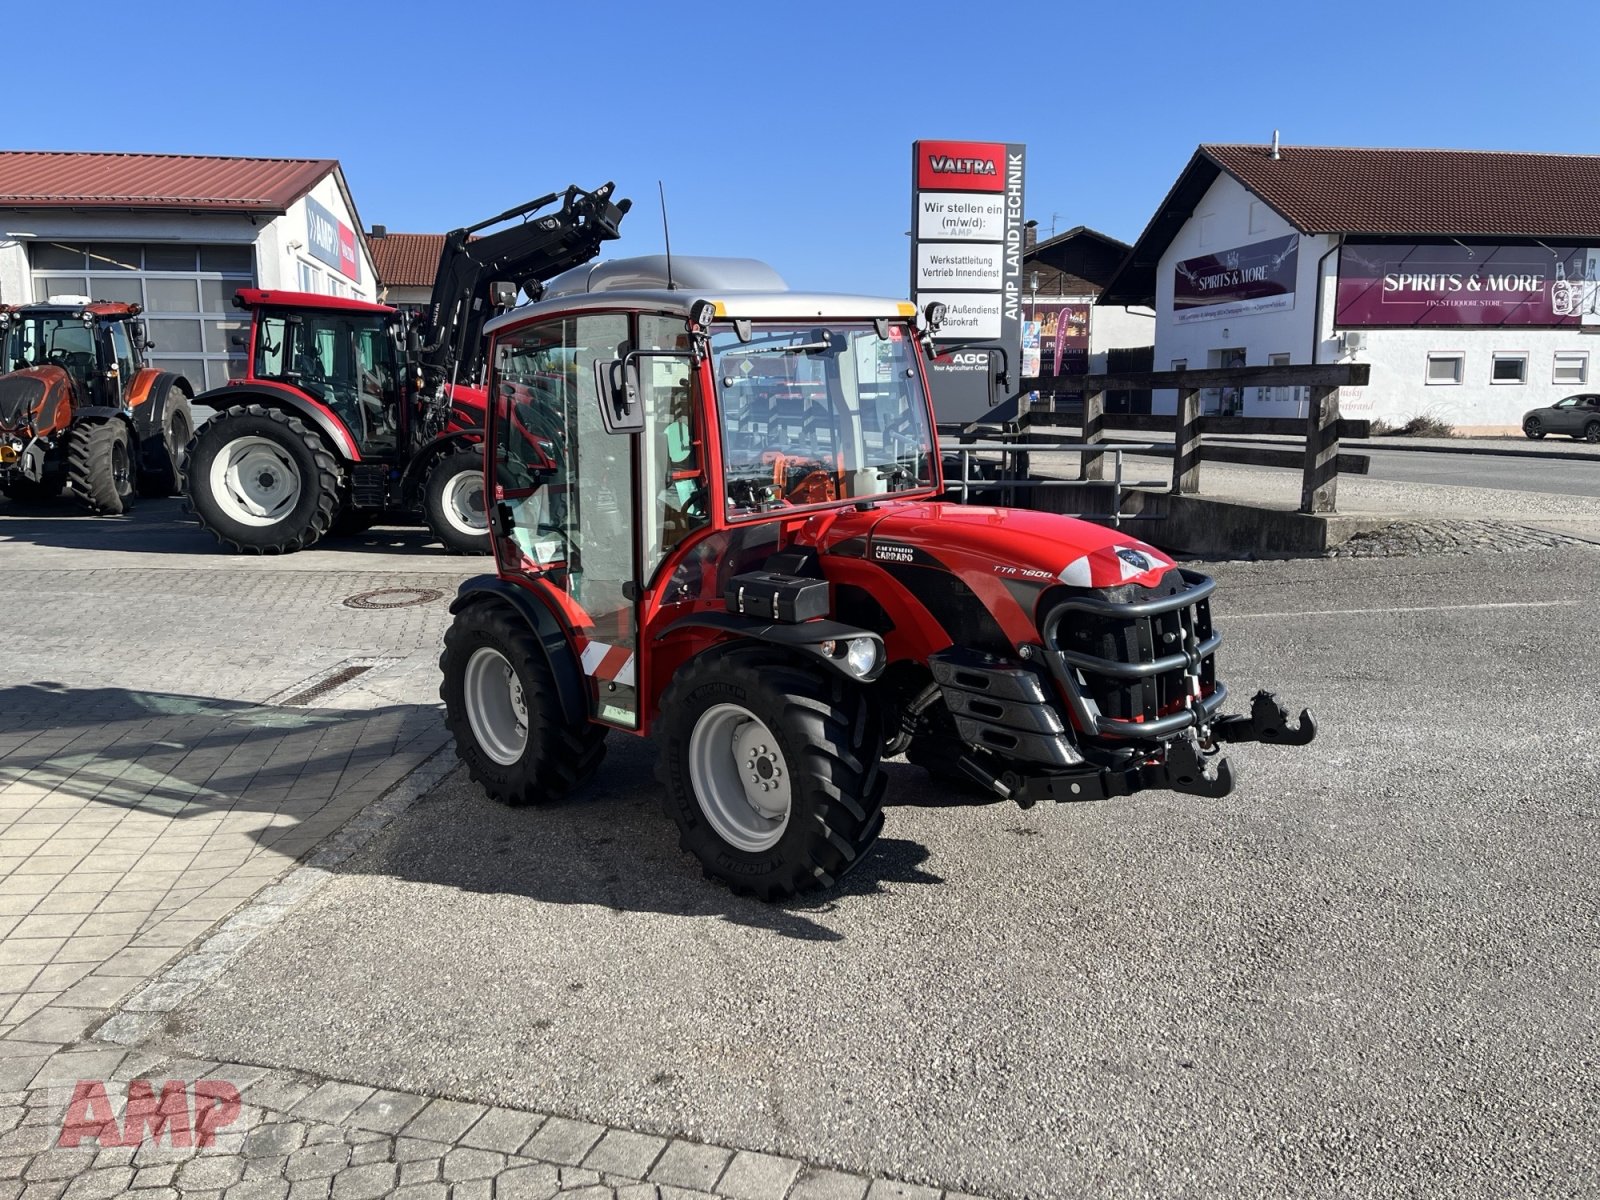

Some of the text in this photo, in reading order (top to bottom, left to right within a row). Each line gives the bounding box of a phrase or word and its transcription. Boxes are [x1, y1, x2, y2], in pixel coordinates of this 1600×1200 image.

[928, 155, 997, 175] VALTRA
[925, 202, 1002, 214] Wir stellen ein
[942, 216, 986, 230] (m/w/d):
[316, 214, 333, 253] AMP
[1005, 154, 1022, 320] AMP LANDTECHNIK
[930, 255, 993, 267] Werkstattleitung
[922, 268, 999, 277] Vertrieb Innendienst
[1199, 265, 1268, 291] SPIRITS & MORE
[1384, 273, 1544, 292] SPIRITS & MORE
[952, 305, 999, 314] Außendienst
[942, 318, 978, 326] Bürokraft
[953, 353, 988, 364] AGC
[1340, 386, 1363, 401] hisky
[876, 546, 914, 554] ANTONIO
[875, 551, 914, 562] CARRARO
[993, 565, 1016, 574] TTR
[694, 682, 746, 700] MICHELIN
